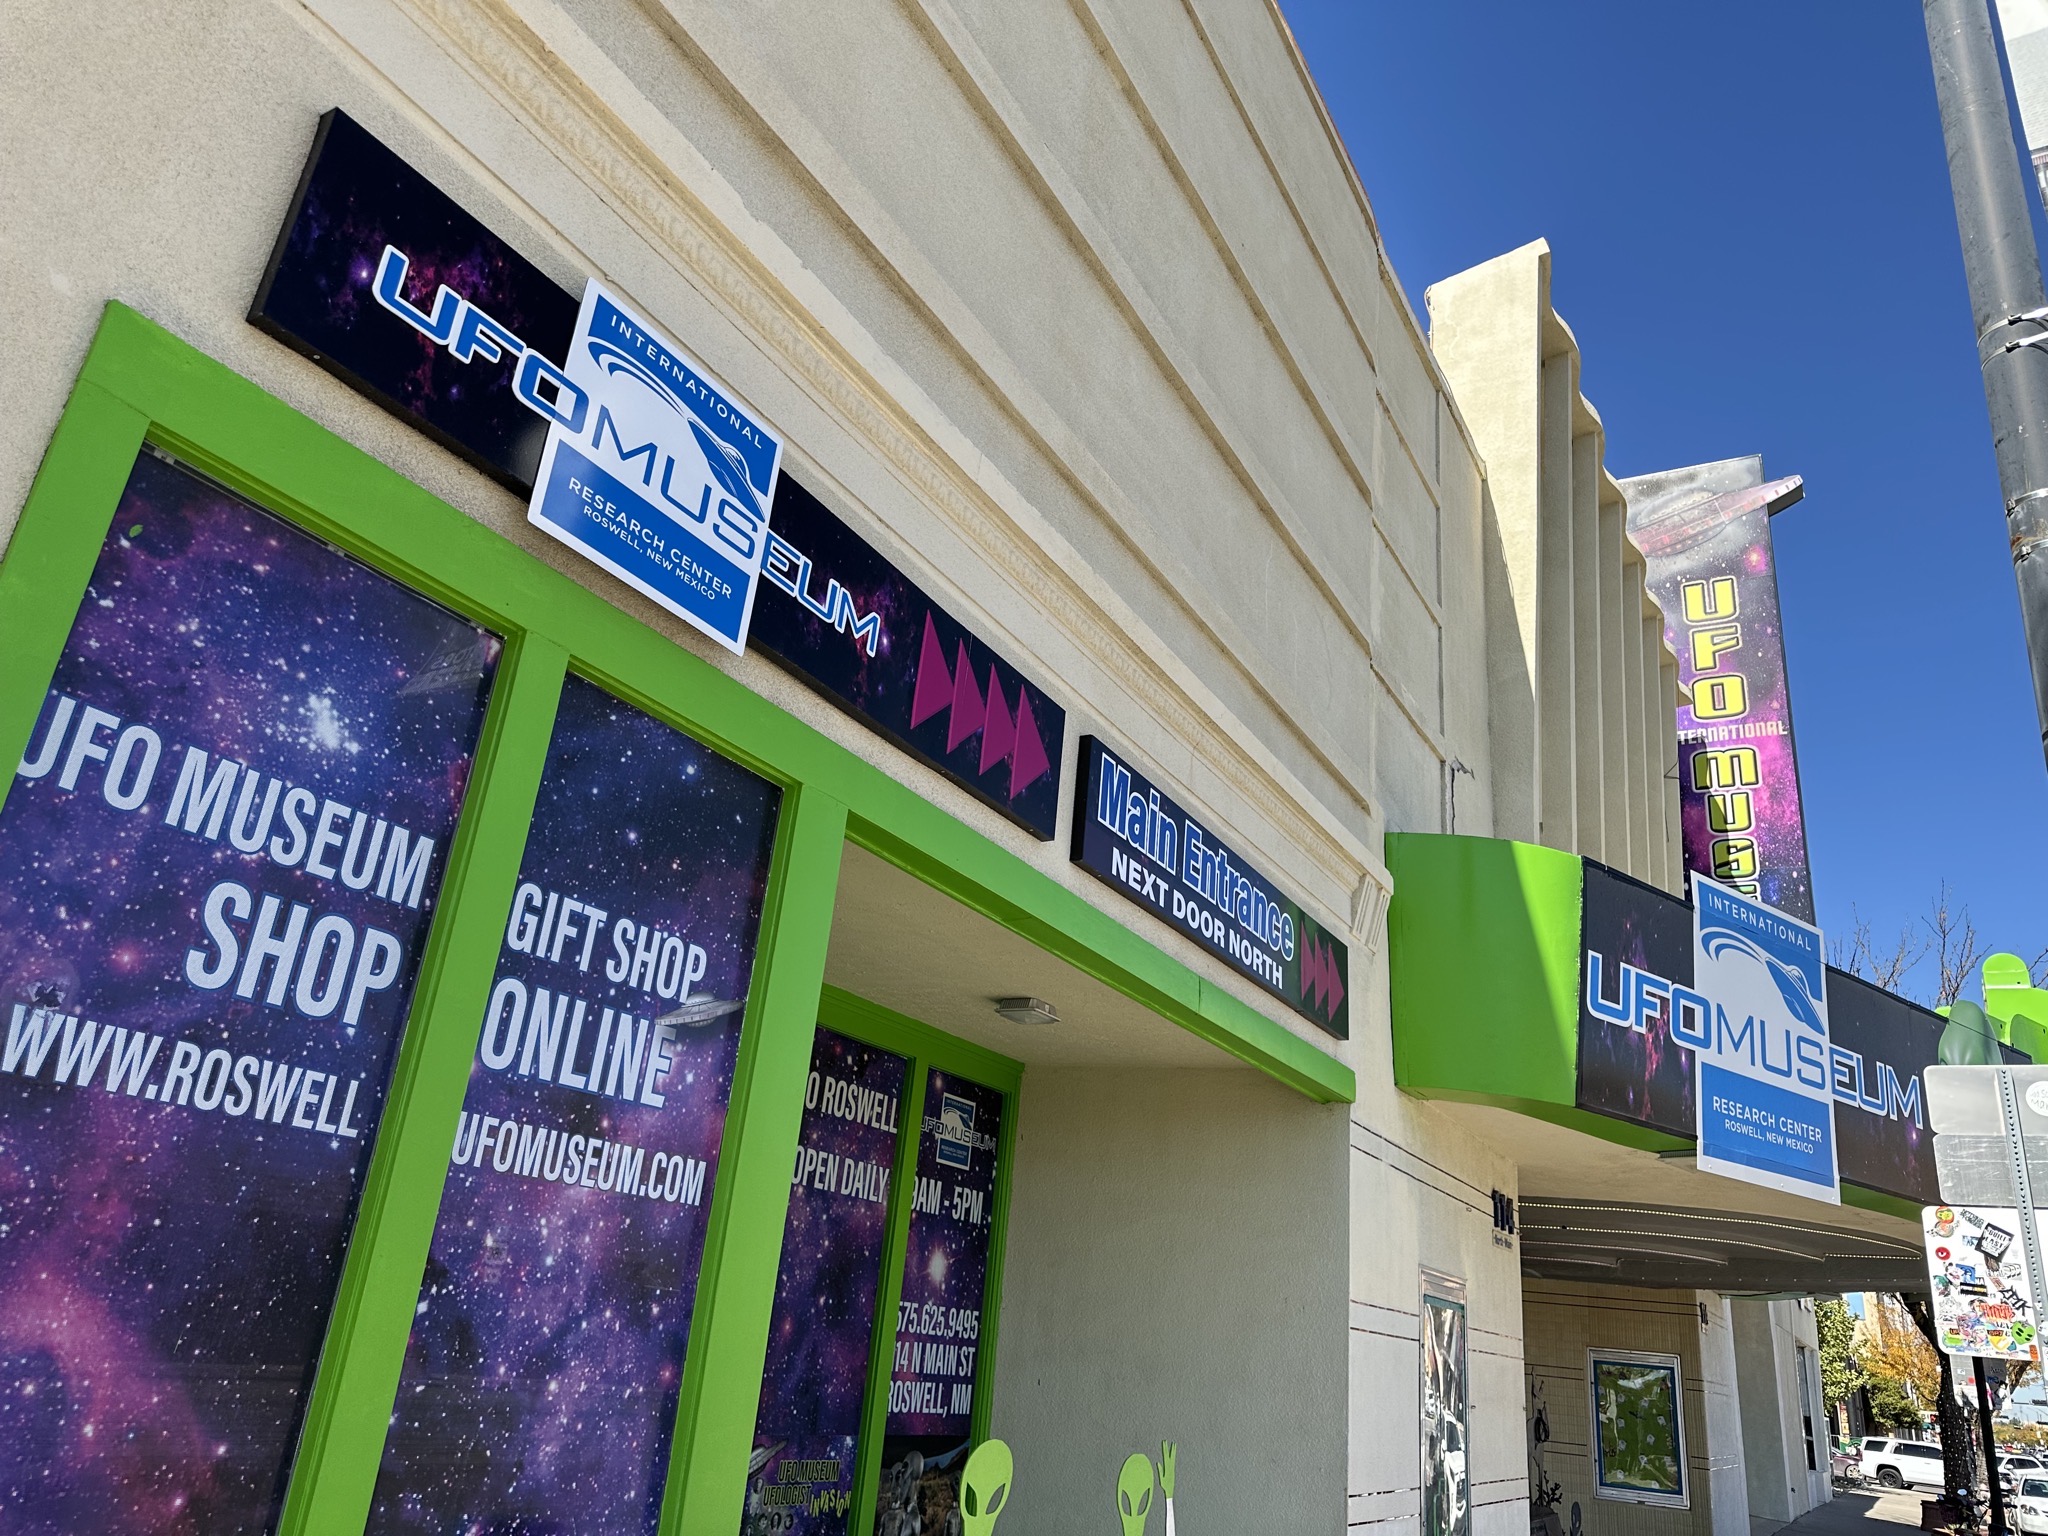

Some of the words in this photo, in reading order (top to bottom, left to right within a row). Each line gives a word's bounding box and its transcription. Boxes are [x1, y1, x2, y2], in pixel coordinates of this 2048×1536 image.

[611, 315, 763, 449] INTERNATIONAL
[568, 478, 665, 551] RESEARCH
[671, 543, 733, 600] CENTER
[583, 506, 643, 555] ROSWELL,
[646, 542, 674, 570] NEW
[675, 559, 716, 600] MEXICO
[1682, 576, 1748, 720] UFO
[1677, 721, 1787, 745] TERNATIONAL
[165, 747, 435, 908] MUSEUM
[1098, 752, 1178, 874] Main
[1183, 819, 1294, 961] Entrance
[186, 881, 401, 1027] SHOP
[507, 883, 606, 971] GIFT
[606, 919, 707, 1003] SHOP
[1112, 847, 1168, 907] NEXT
[1173, 889, 1225, 948] DOOR
[1229, 928, 1283, 989] NORTH
[1709, 893, 1812, 952] INTERNATIONAL
[2, 1003, 359, 1138] WWW.ROSWELL
[481, 978, 677, 1108] ONLINE
[822, 1076, 898, 1134] ROSWELL
[1712, 1096, 1776, 1129] RESEARCH
[1779, 1115, 1823, 1143] CENTER
[1725, 1119, 1765, 1140] ROSWELL,
[1766, 1132, 1784, 1146] NEW
[1786, 1137, 1814, 1155] MEXICO
[451, 1111, 707, 1206] UFOMUSEUM.COM
[792, 1145, 839, 1192] OPEN
[841, 1158, 889, 1203] DAILY
[952, 1186, 984, 1224] 5PM
[911, 1342, 922, 1373] N
[924, 1343, 958, 1376] MAIN
[959, 1346, 976, 1377] ST
[950, 1384, 972, 1415] NM
[763, 1485, 812, 1507] UFOLOGIST
[810, 1489, 851, 1518] INVASION
[778, 1460, 799, 1482] UFO
[800, 1460, 840, 1481] MUSEUM
